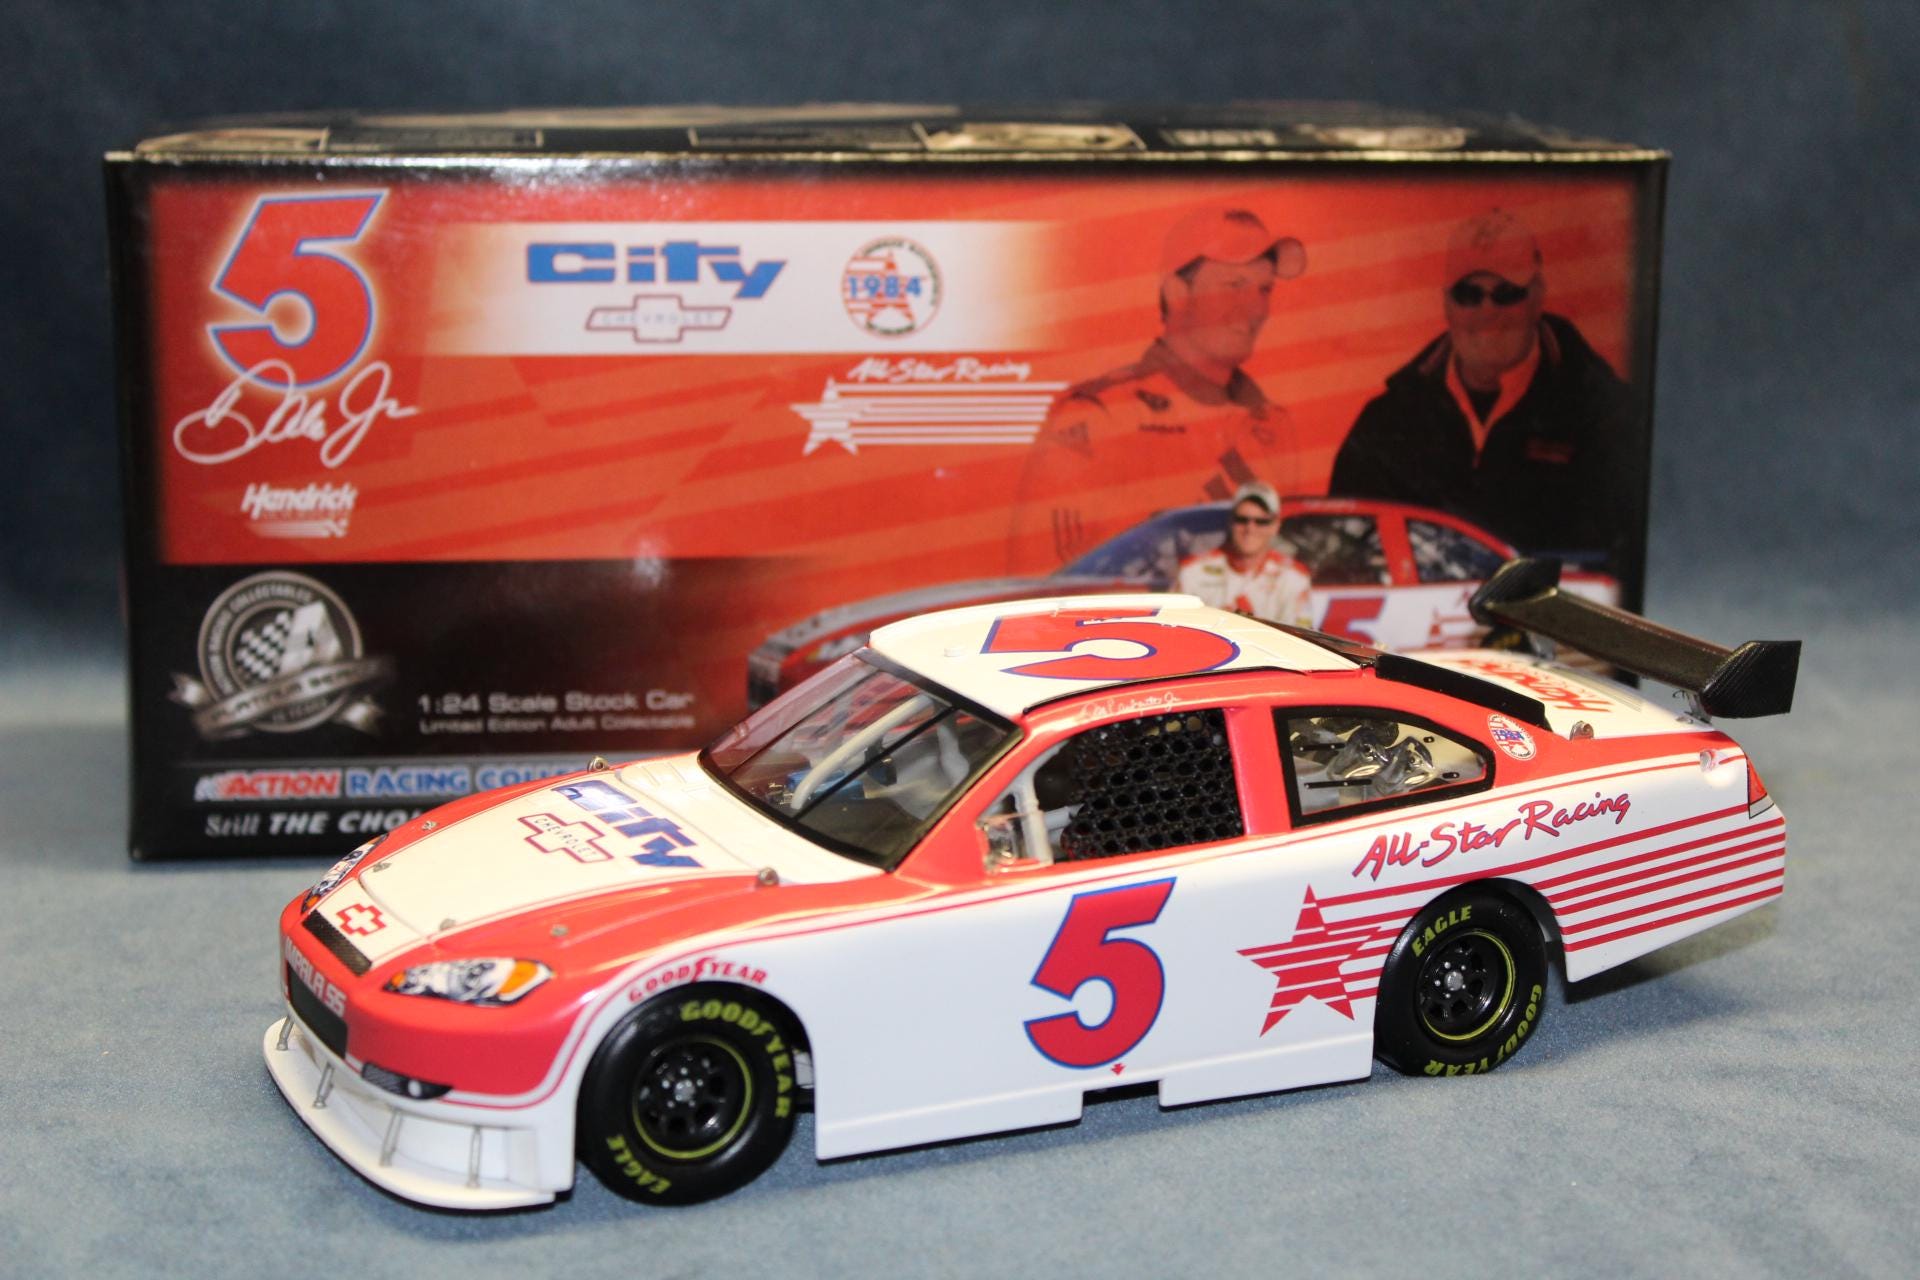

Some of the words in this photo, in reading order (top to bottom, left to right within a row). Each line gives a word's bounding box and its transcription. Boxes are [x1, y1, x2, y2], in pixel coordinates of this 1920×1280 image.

[209, 189, 388, 389] 5
[527, 241, 787, 299] City
[848, 275, 921, 298] 1984
[241, 483, 358, 519] Hendrick
[980, 606, 1241, 682] 5
[418, 694, 481, 715] 1:24
[487, 691, 559, 713] Scale
[564, 690, 638, 712] Stock
[645, 689, 694, 711] Car
[222, 769, 341, 798] ACTION
[345, 767, 471, 797] RACING
[205, 813, 261, 837] Still
[268, 811, 329, 835] THE
[534, 817, 598, 858] CHEVROLET
[551, 780, 705, 868] City
[1518, 791, 1632, 841] Racing
[1411, 904, 1472, 957] EAGLE
[629, 956, 768, 1002] GOODYEAR
[1023, 876, 1178, 1070] 5
[1424, 984, 1542, 1077] GOODYEAR
[680, 998, 793, 1119] GOODYEAR
[606, 1134, 672, 1194] EAGLE
